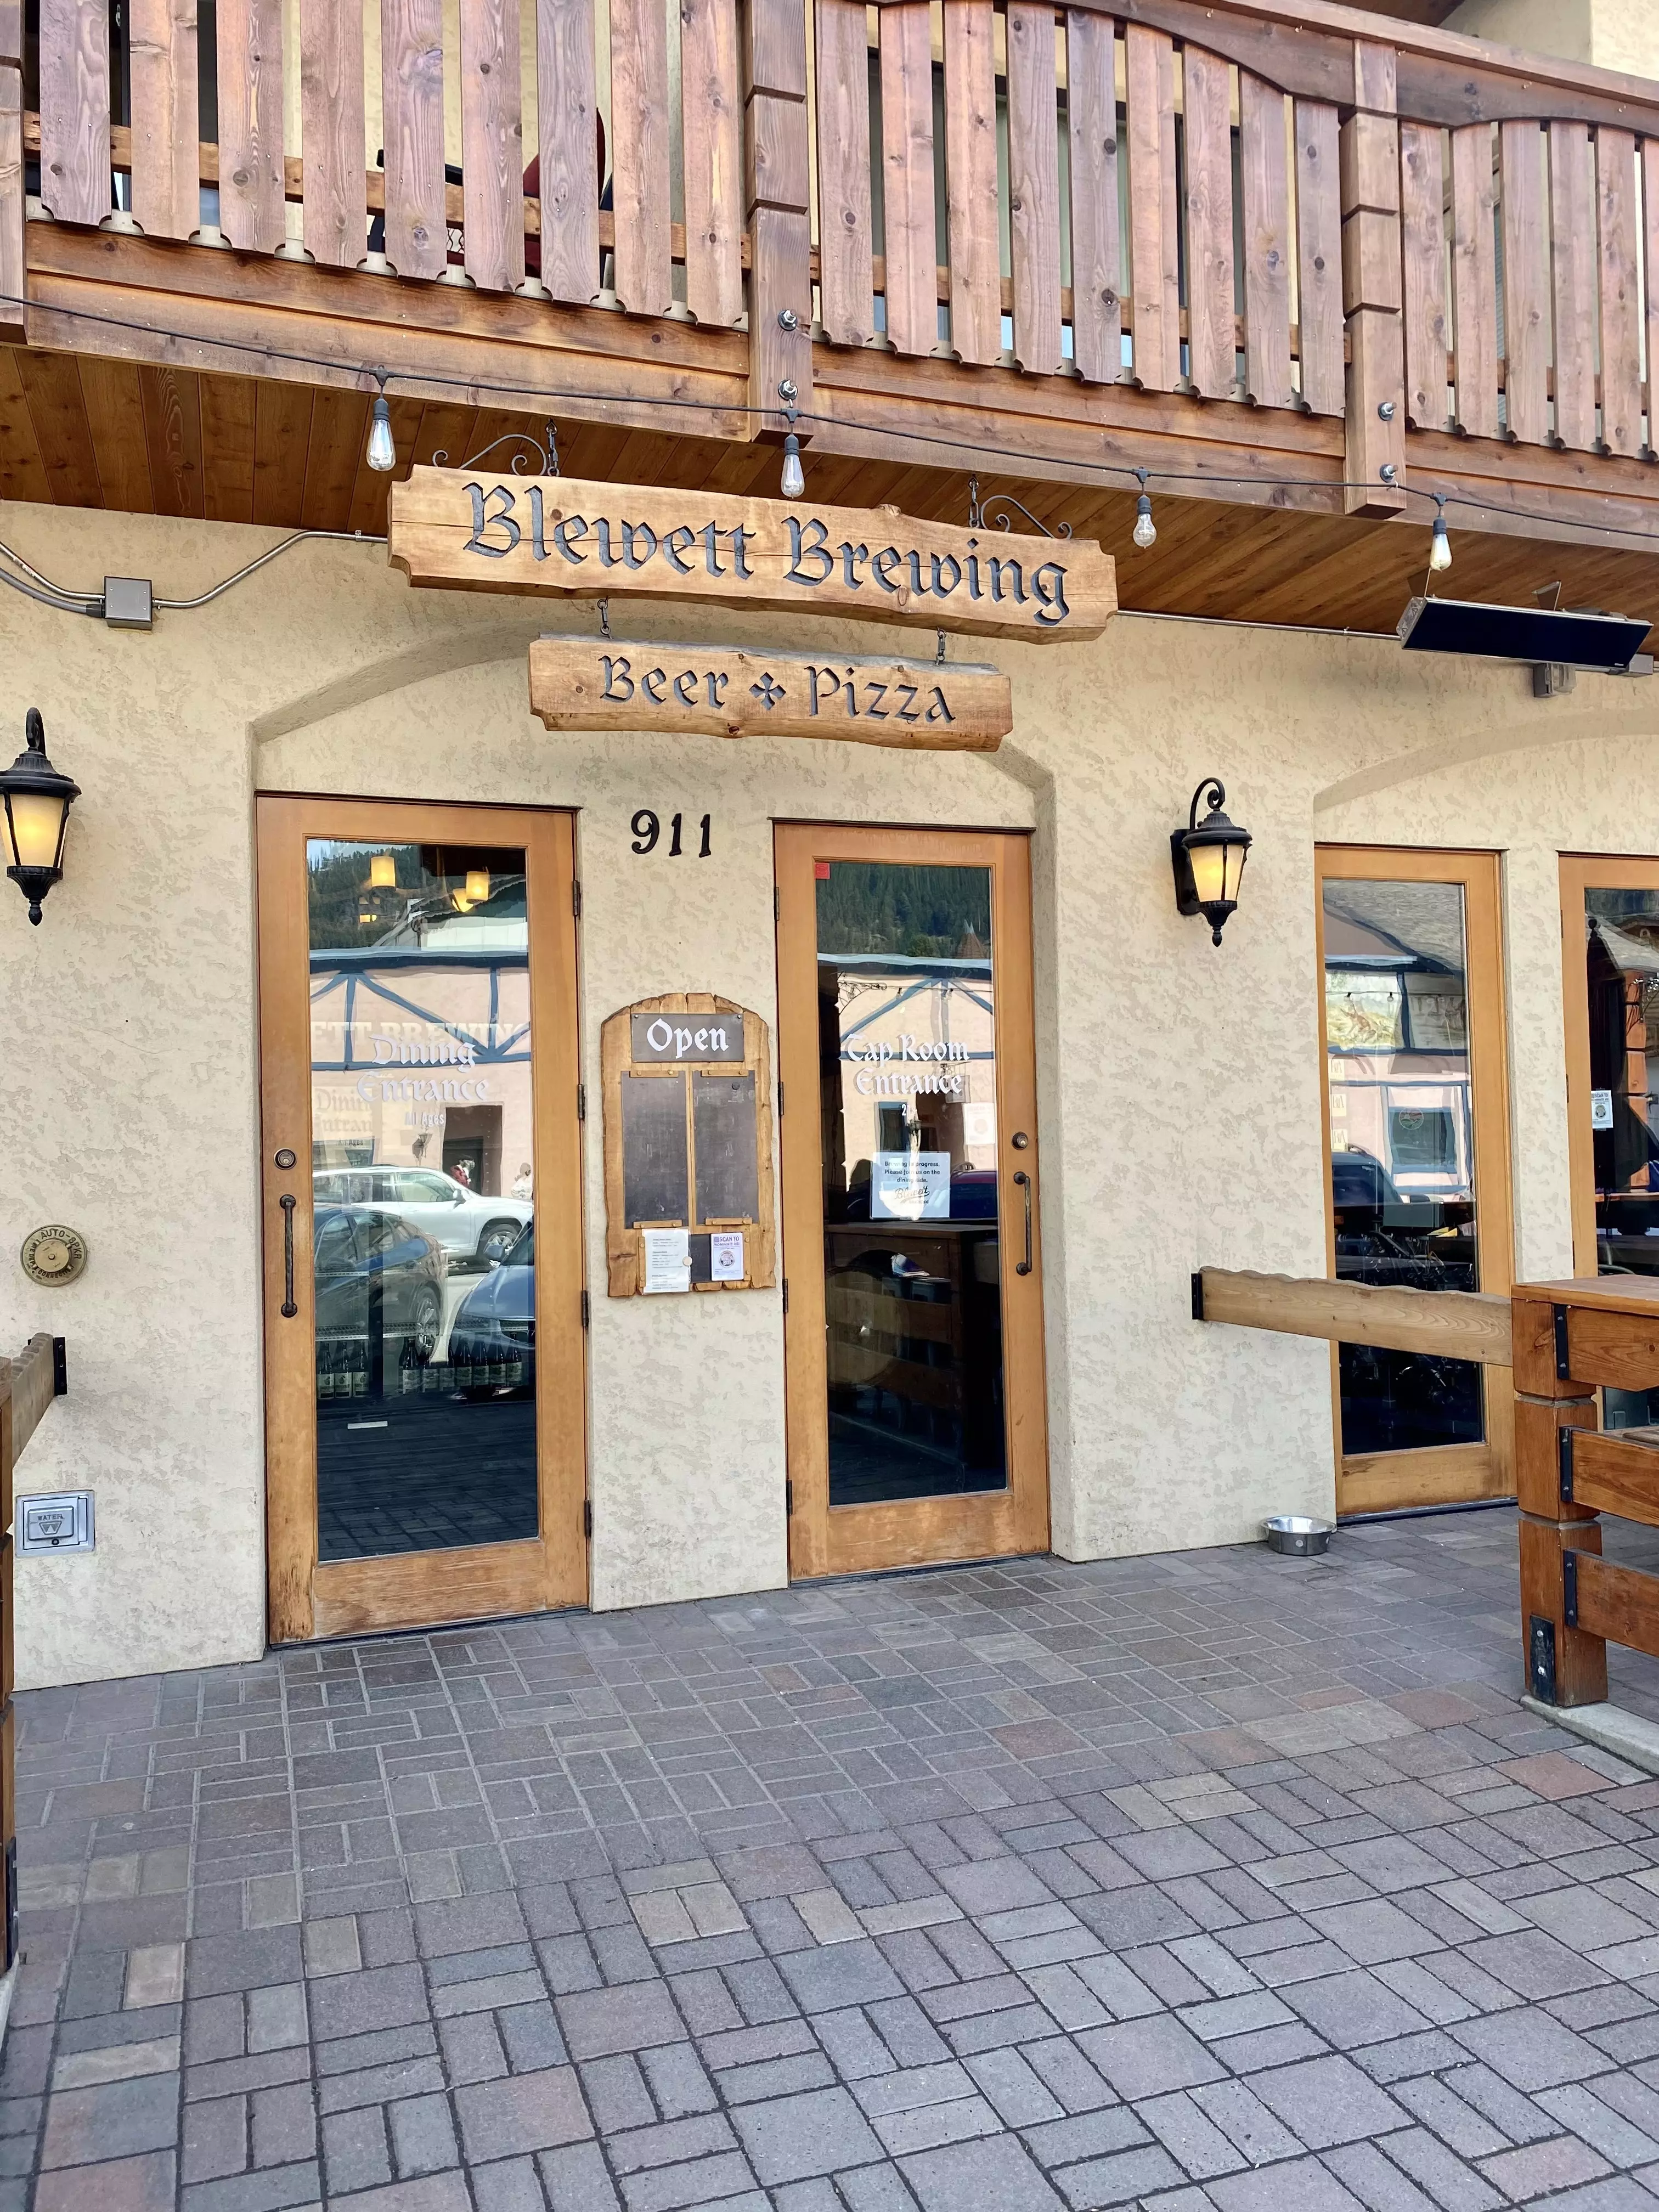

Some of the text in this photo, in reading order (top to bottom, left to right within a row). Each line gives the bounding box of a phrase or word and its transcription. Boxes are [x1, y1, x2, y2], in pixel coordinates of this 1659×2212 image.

[462, 482, 1069, 627] Blewett Brewing
[597, 654, 956, 724] Beer Pizza
[631, 809, 712, 858] 911
[369, 1034, 476, 1073] Dining
[646, 1018, 729, 1059] Open
[846, 1033, 970, 1067] Tap Room
[357, 1070, 490, 1103] Entrance
[855, 1067, 962, 1095] Entrance
[421, 1111, 445, 1126] Ages
